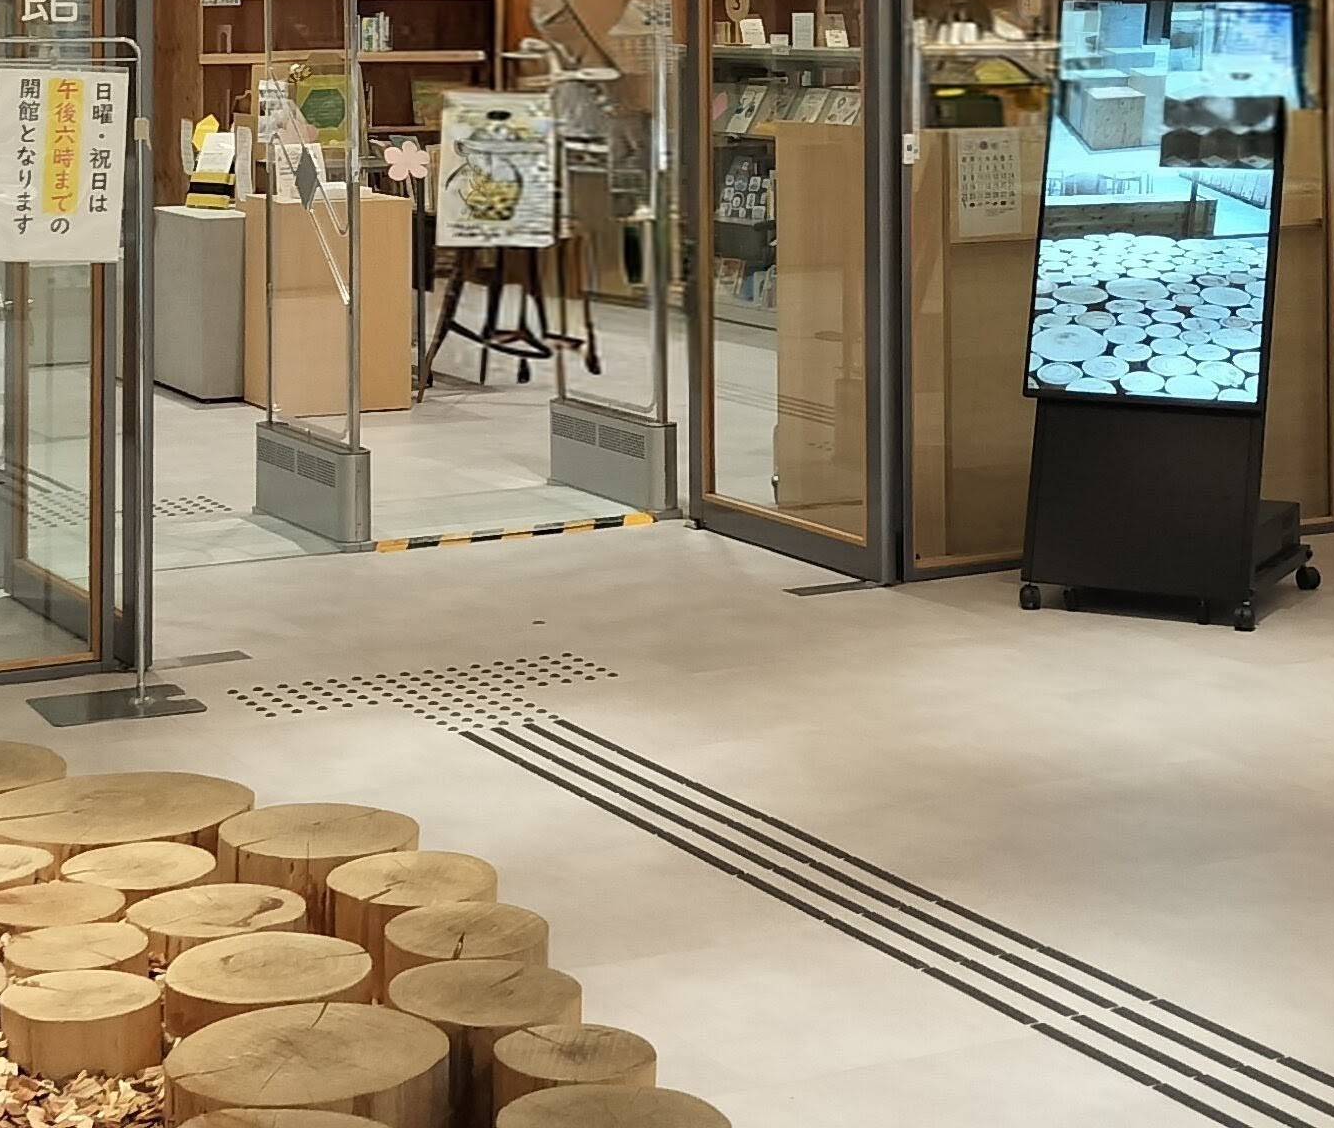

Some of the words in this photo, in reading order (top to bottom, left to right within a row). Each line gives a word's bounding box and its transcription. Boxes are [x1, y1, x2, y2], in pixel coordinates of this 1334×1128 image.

[13, 78, 41, 235] 開館となります
[50, 79, 79, 235] 午後六時までの
[89, 82, 114, 213] 日曜・祝日は
